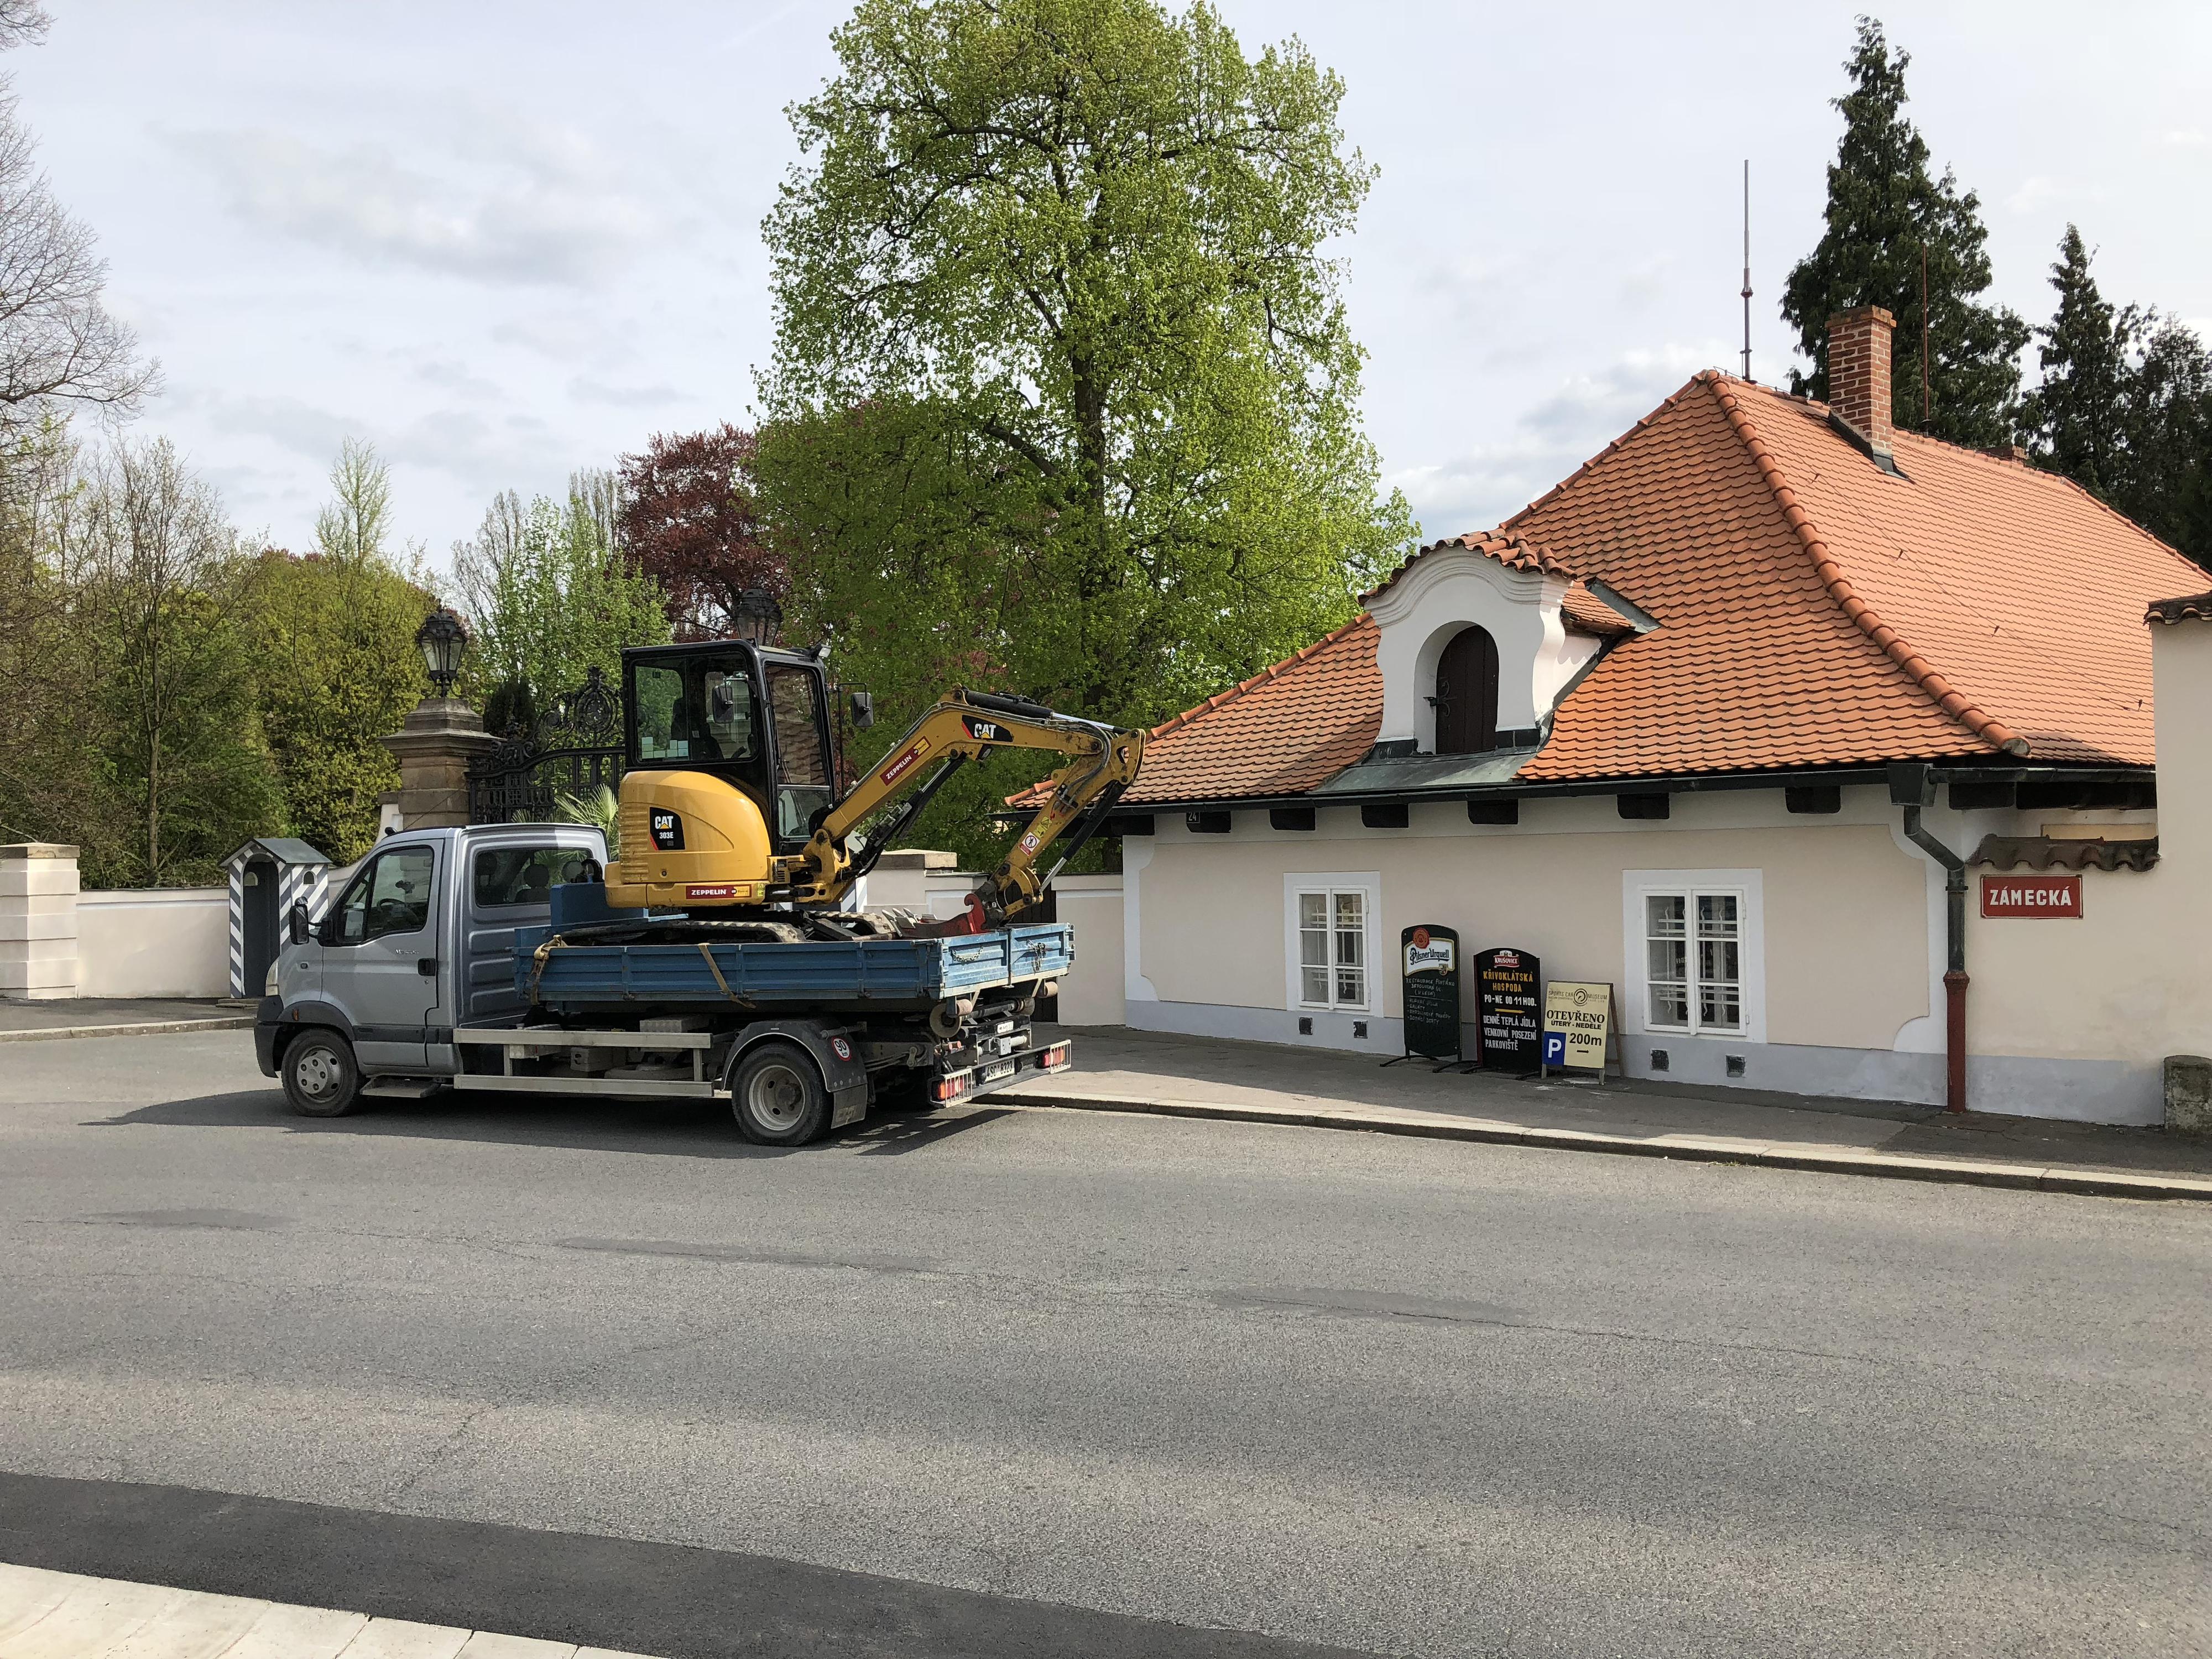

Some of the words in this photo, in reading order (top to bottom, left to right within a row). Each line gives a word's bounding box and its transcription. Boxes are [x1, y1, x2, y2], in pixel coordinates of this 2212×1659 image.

[974, 723, 996, 739] CAT
[885, 755, 912, 780] ZEPPELIN
[655, 816, 674, 829] CAT
[1990, 886, 2072, 906] ZÁMECKÁ
[1410, 947, 1430, 965] Pilsner
[1429, 948, 1449, 962] Urquell
[1483, 968, 1533, 982] KŘIVOKLÁTSKÁ
[1493, 982, 1522, 992] HOSPODA
[1484, 994, 1503, 1004] PO-NE
[1505, 996, 1512, 1004] OD
[1514, 997, 1522, 1005] 11
[1522, 997, 1537, 1006] HOD.
[1483, 1014, 1500, 1025] DENNĚ
[1501, 1015, 1519, 1026] TEPLÁ
[1520, 1016, 1536, 1027] JÍDLA
[1547, 1010, 1605, 1024] OTEVŘENO
[1484, 1027, 1509, 1037] VENKOVNÍ
[1511, 1029, 1537, 1040] POSEZENÍ
[1569, 1032, 1601, 1046] 200m
[834, 1040, 847, 1051] 90
[1485, 1039, 1518, 1051] PARKOVIŠTĚ
[1548, 1039, 1562, 1058] P
